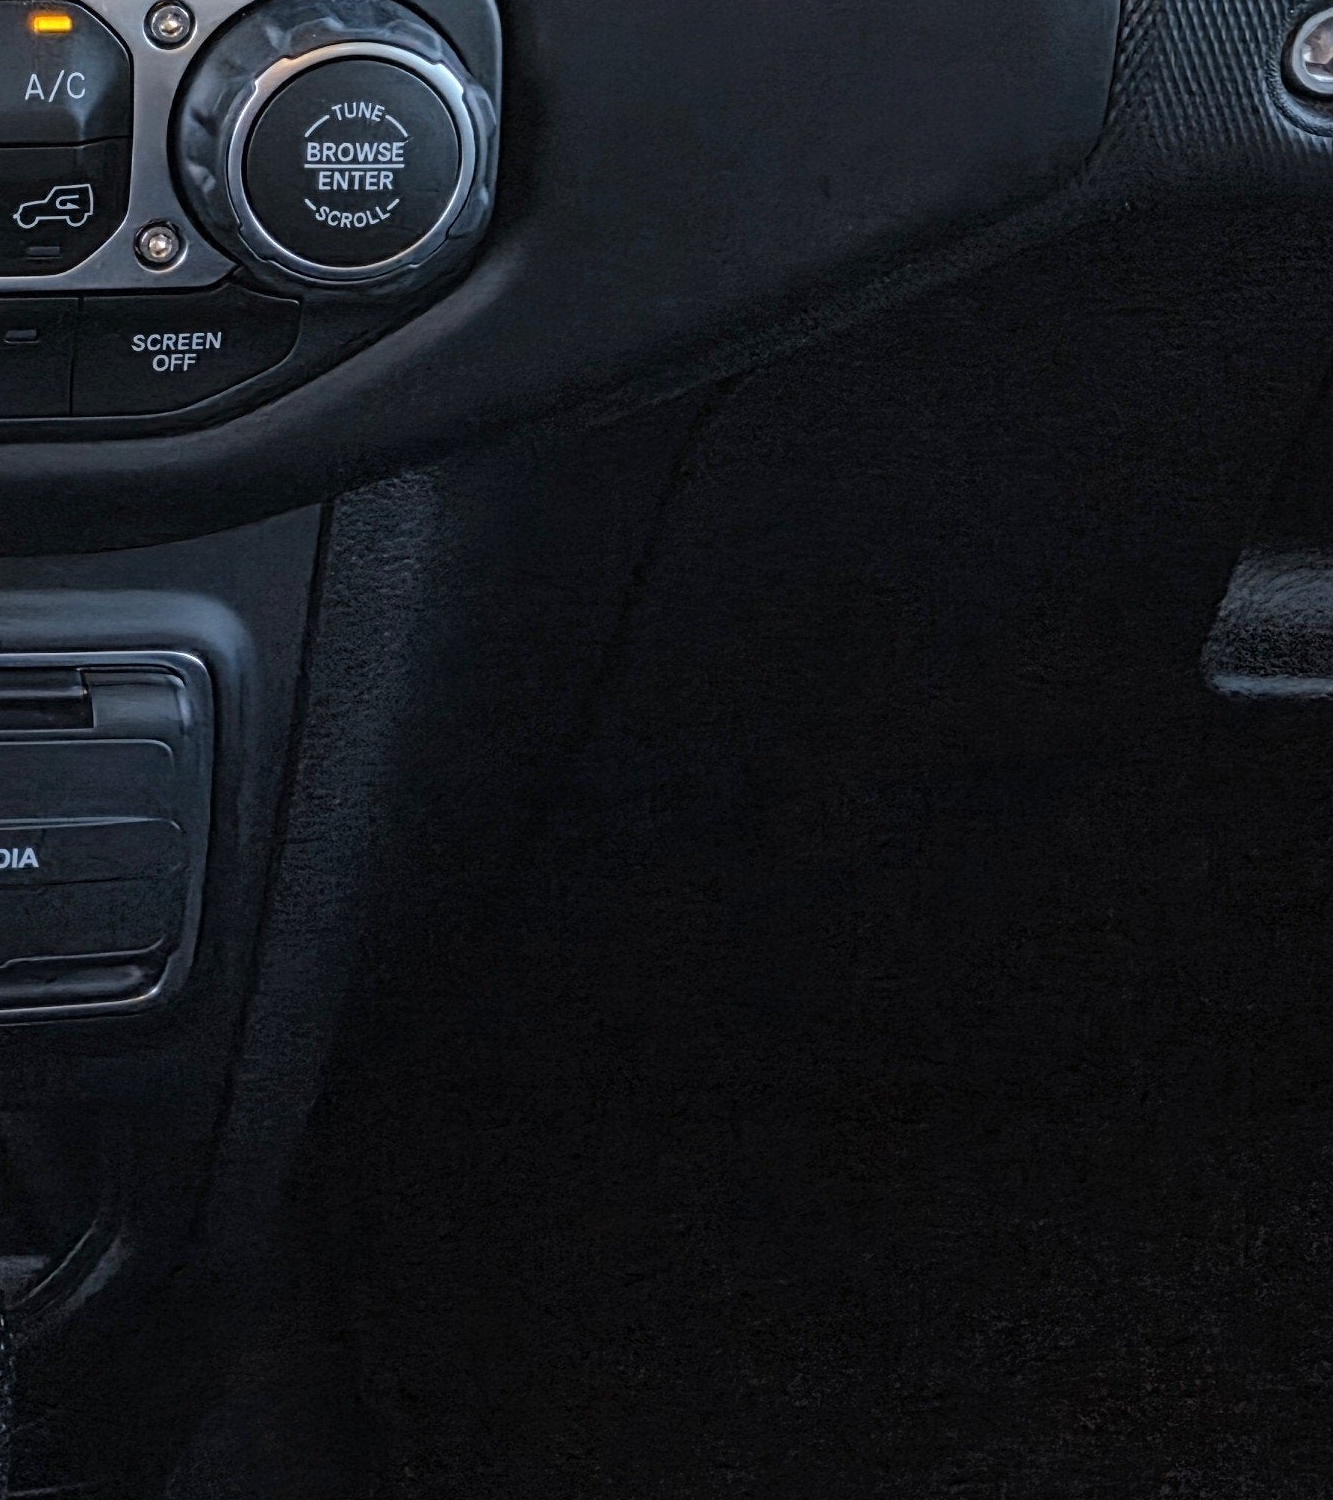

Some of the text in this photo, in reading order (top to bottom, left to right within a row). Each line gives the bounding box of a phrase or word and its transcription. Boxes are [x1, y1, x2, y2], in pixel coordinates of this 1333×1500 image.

[24, 69, 86, 103] A/C
[329, 100, 386, 122] TUNE
[306, 140, 405, 162] BROWSE
[318, 170, 394, 191] ENTER
[314, 204, 390, 230] SCROLL
[131, 331, 222, 352] SCREEN
[152, 353, 197, 372] OFF
